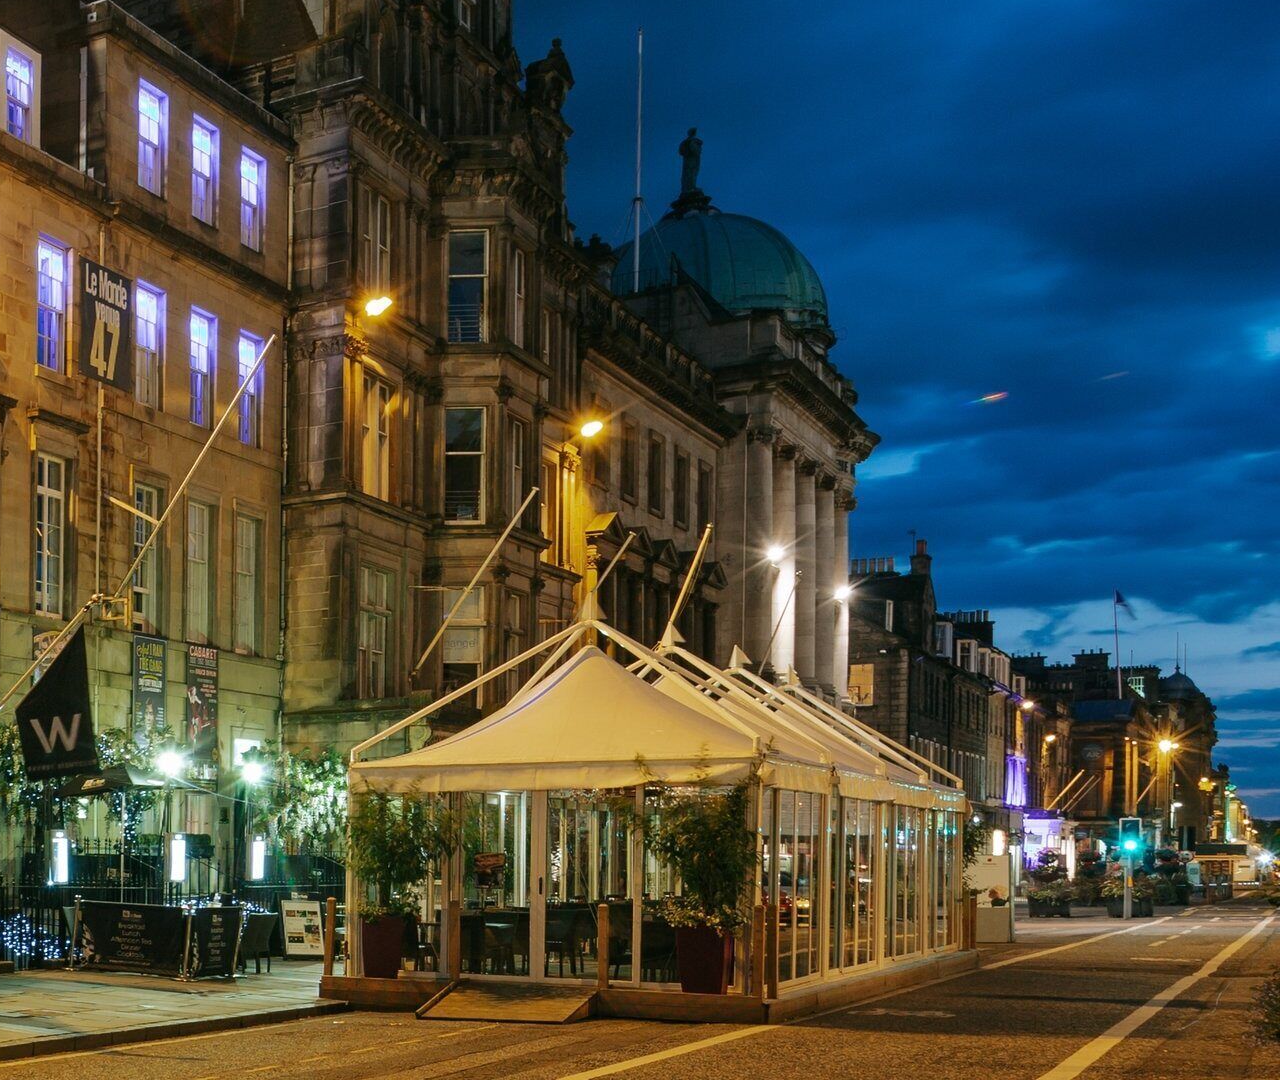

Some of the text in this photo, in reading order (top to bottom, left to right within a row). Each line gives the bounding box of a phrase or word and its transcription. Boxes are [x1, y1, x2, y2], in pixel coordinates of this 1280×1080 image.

[85, 263, 127, 310] Le Monde
[90, 320, 120, 380] 47
[189, 645, 217, 660] CABARET
[29, 713, 82, 754] W
